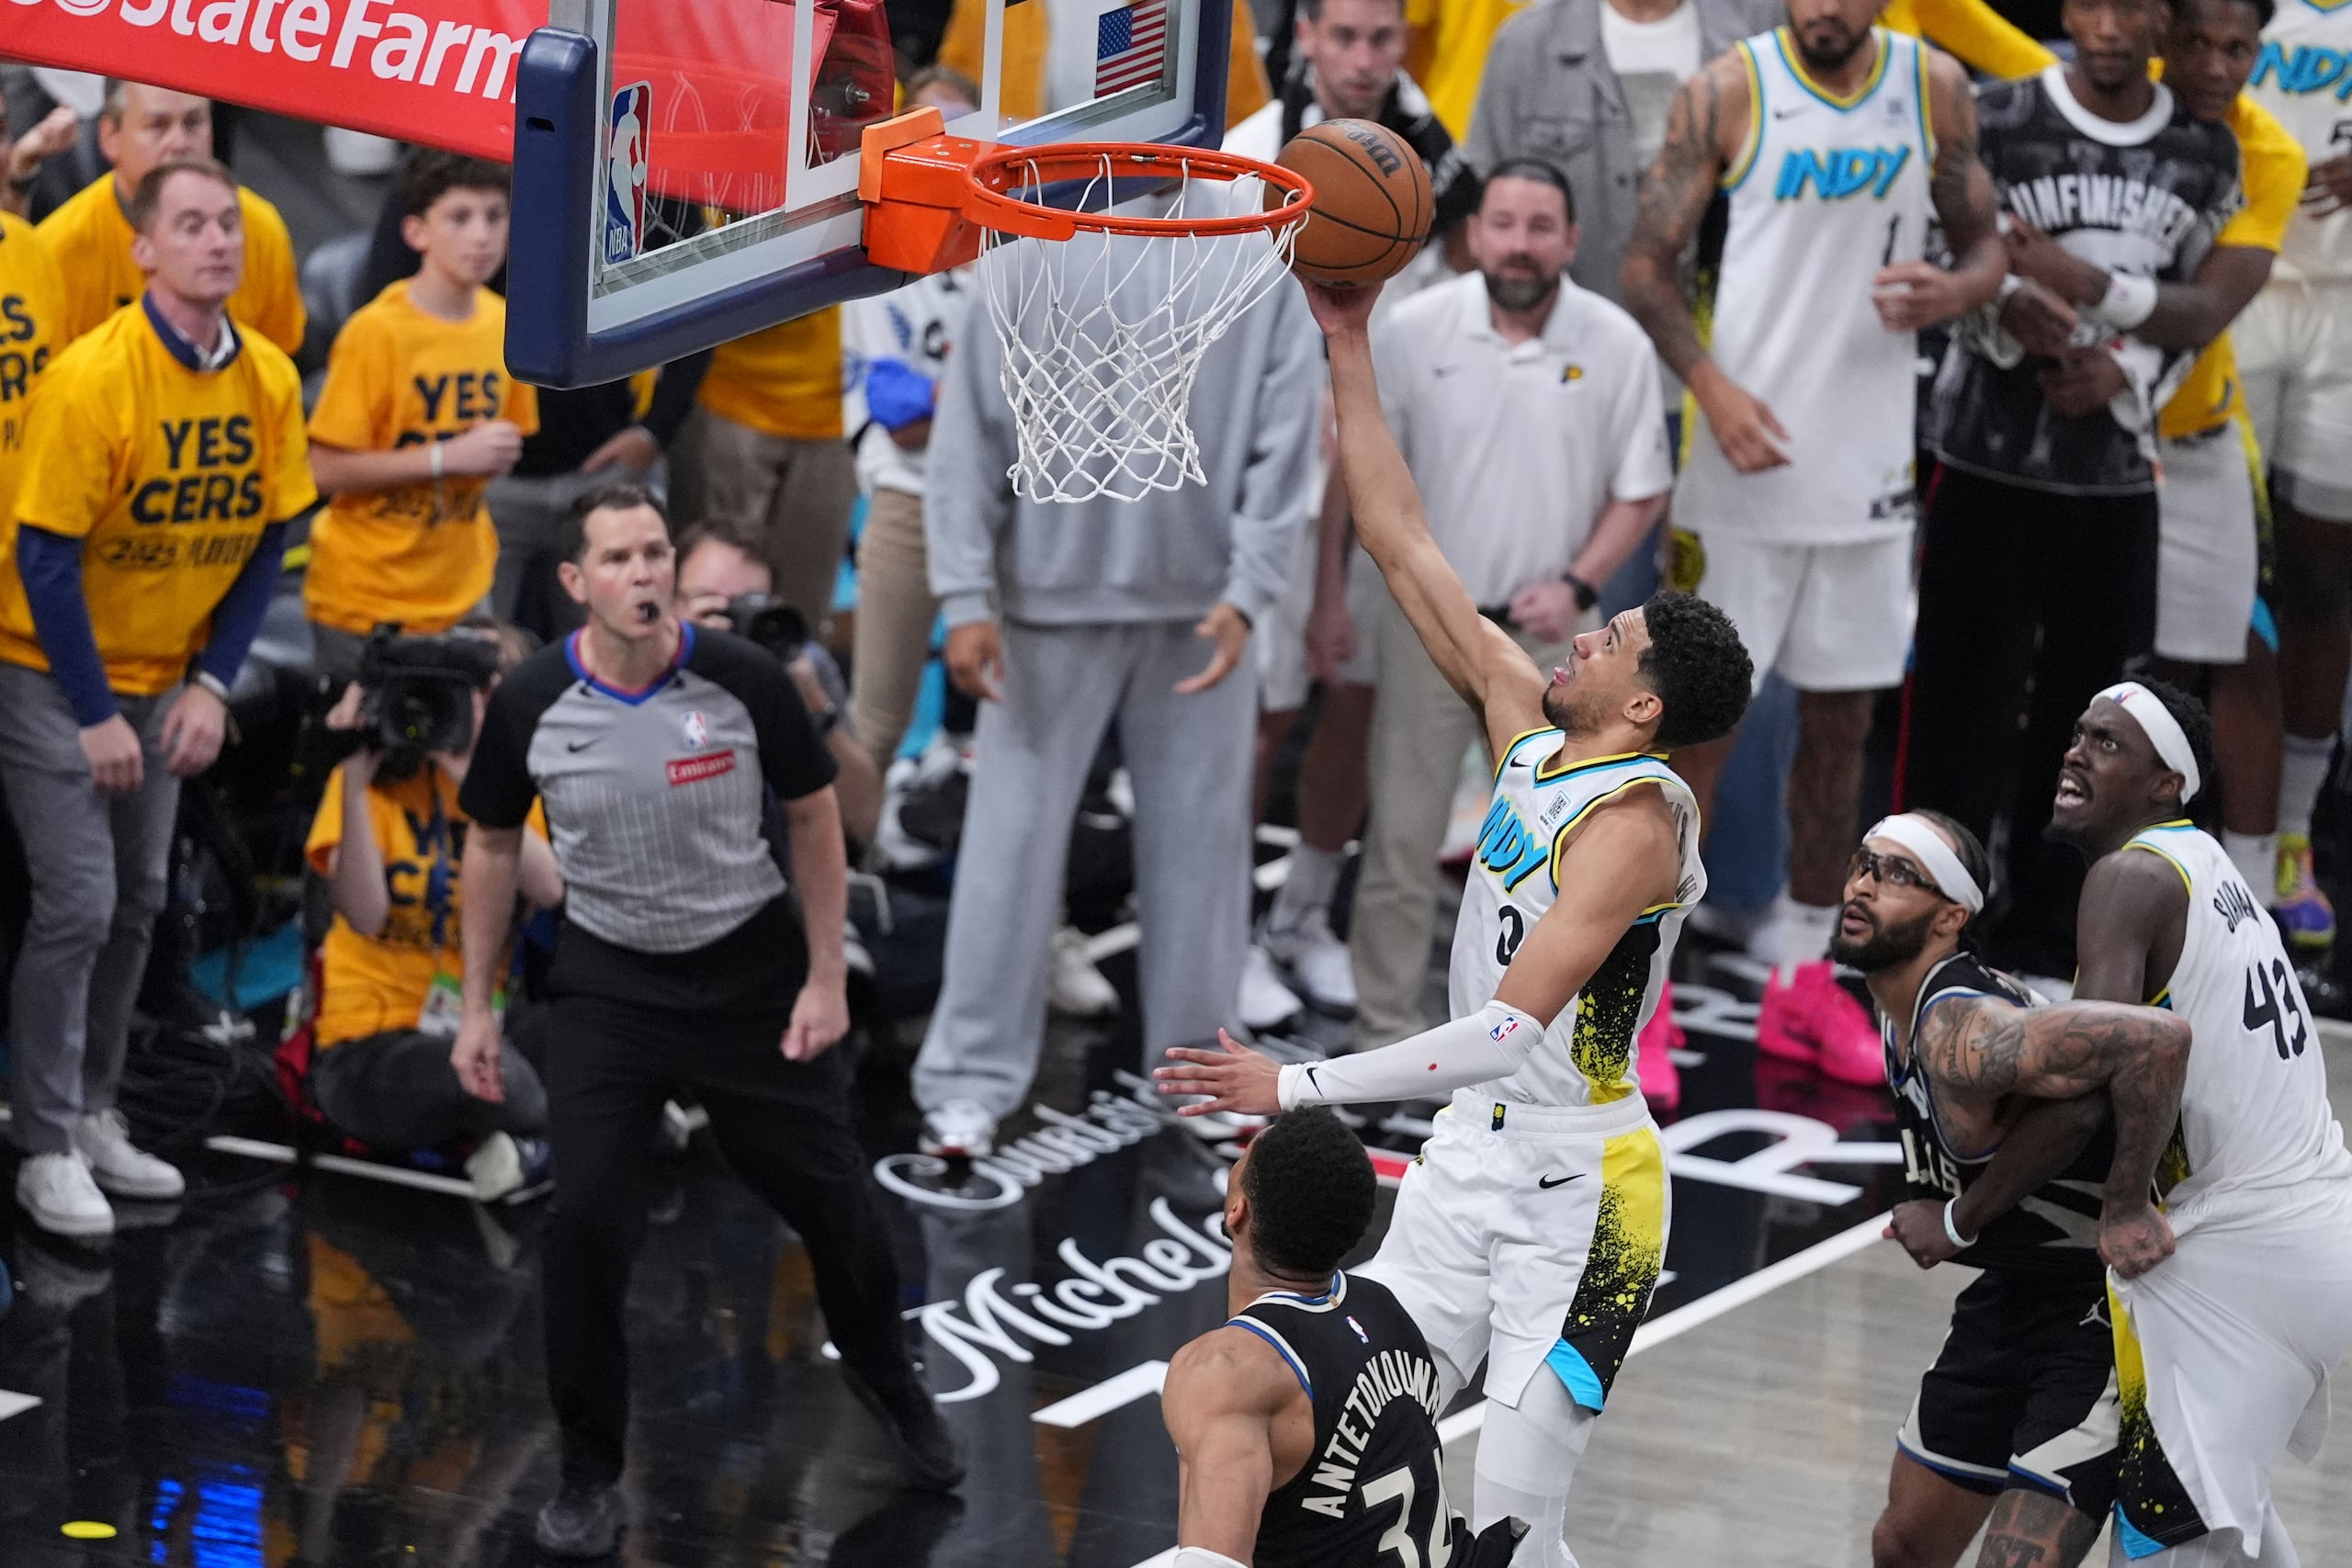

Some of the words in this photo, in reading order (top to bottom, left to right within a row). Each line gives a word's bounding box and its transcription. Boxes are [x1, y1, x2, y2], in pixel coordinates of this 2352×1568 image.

[1774, 144, 1912, 201] INDY
[609, 226, 628, 257] NBA
[415, 373, 500, 422] YES
[162, 416, 254, 468] YES
[1496, 905, 1524, 966] 0
[2243, 956, 2307, 1061] 43
